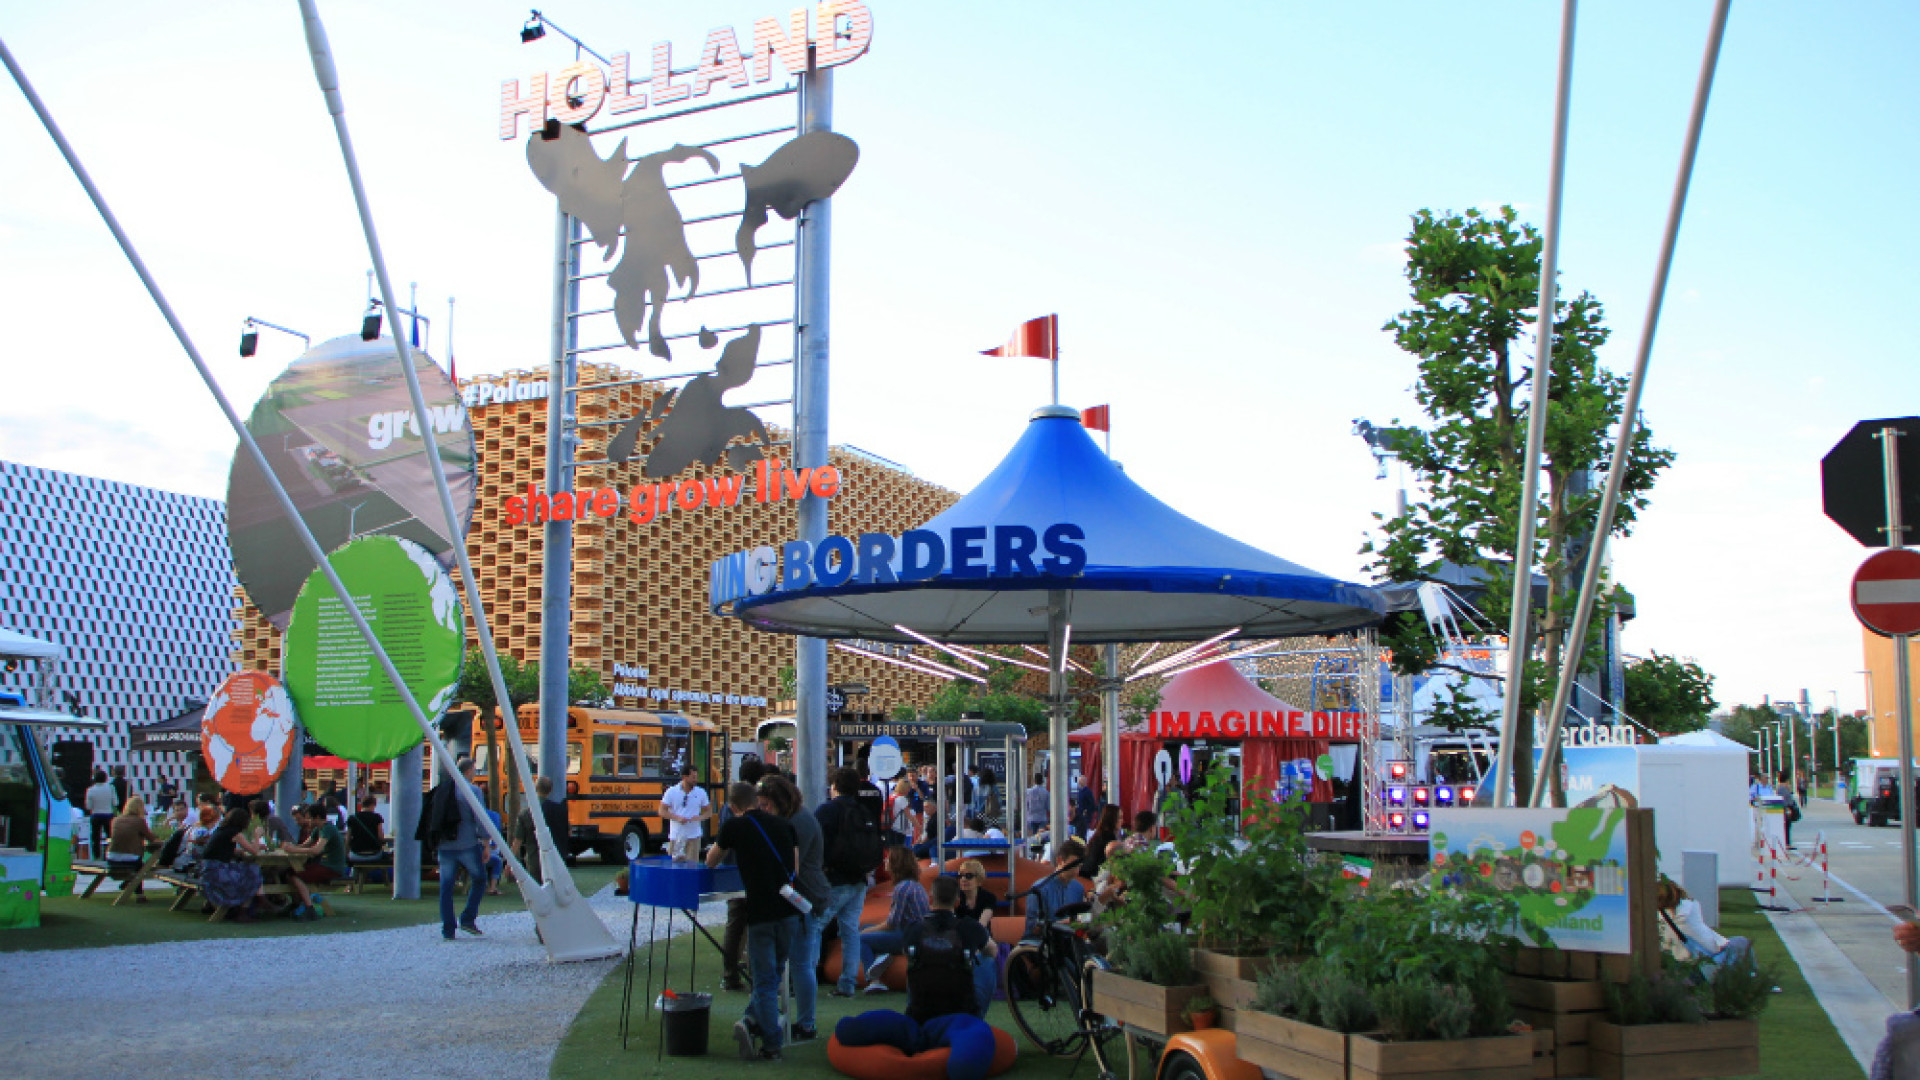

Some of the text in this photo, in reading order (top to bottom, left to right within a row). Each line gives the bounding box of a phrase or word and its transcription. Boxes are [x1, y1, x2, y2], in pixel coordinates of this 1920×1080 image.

[499, 0, 874, 141] HOLLAND
[463, 378, 549, 407] #Polan
[368, 404, 466, 450] grow
[504, 458, 842, 525] share grow live
[782, 522, 1088, 591] BORDERS
[840, 724, 875, 735] DUTCH
[876, 724, 907, 735] FRIES
[909, 724, 919, 735] &
[1147, 710, 1306, 738] IMAGINE
